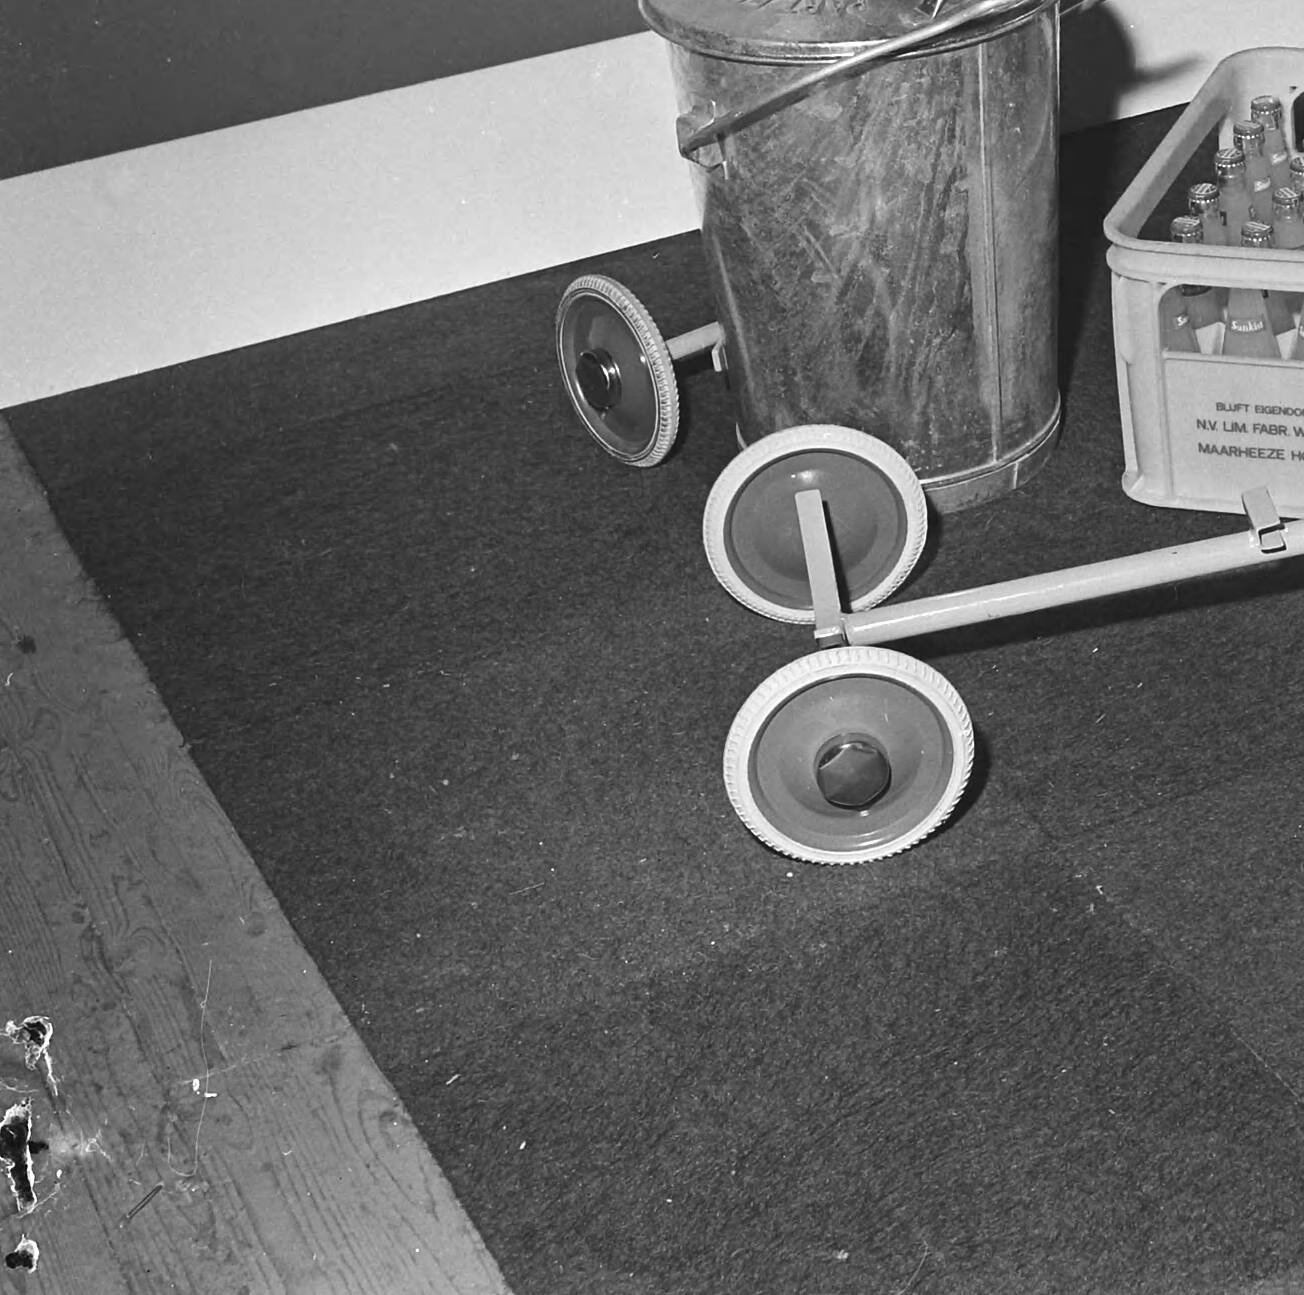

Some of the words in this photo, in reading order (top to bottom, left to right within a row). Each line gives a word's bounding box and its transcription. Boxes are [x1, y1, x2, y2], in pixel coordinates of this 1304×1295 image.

[1216, 402, 1249, 413] BLIJFT
[1196, 418, 1218, 432] N.V.
[1253, 423, 1290, 437] FABR.
[1198, 443, 1285, 461] MAARHEEZE
